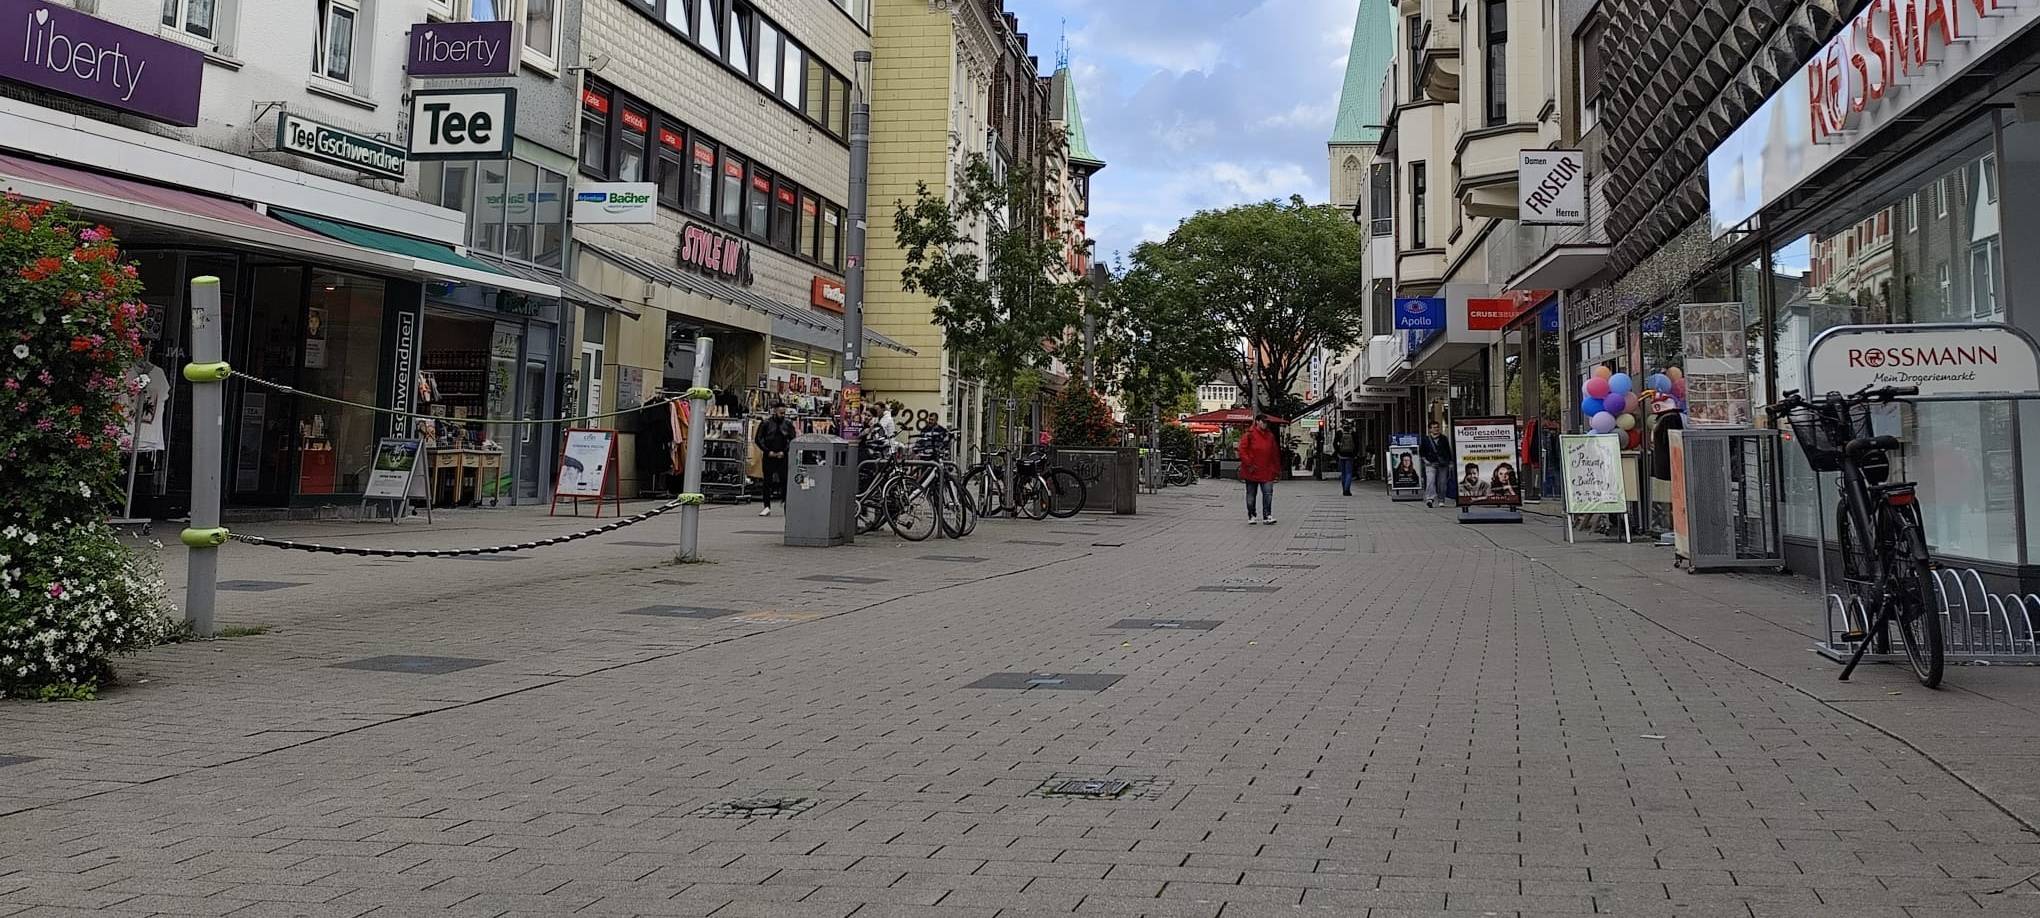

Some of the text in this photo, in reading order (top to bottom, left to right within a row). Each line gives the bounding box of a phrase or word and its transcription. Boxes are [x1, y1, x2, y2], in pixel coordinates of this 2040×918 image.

[23, 9, 146, 102] liberty
[417, 30, 500, 66] liberty
[1808, 0, 1998, 145] ROSSMA
[423, 103, 493, 145] Tee
[289, 121, 405, 172] Tee Gschwendner
[1524, 156, 1547, 166] Damen
[1525, 155, 1581, 215] FRISEUR
[1555, 207, 1580, 217] Herren
[682, 225, 741, 276] STYLE IN
[1400, 315, 1432, 329] Apollo
[1849, 345, 1998, 368] ROSSMANN
[1873, 371, 1977, 386] Mein Drogeriemarkt
[901, 408, 929, 431] 28
